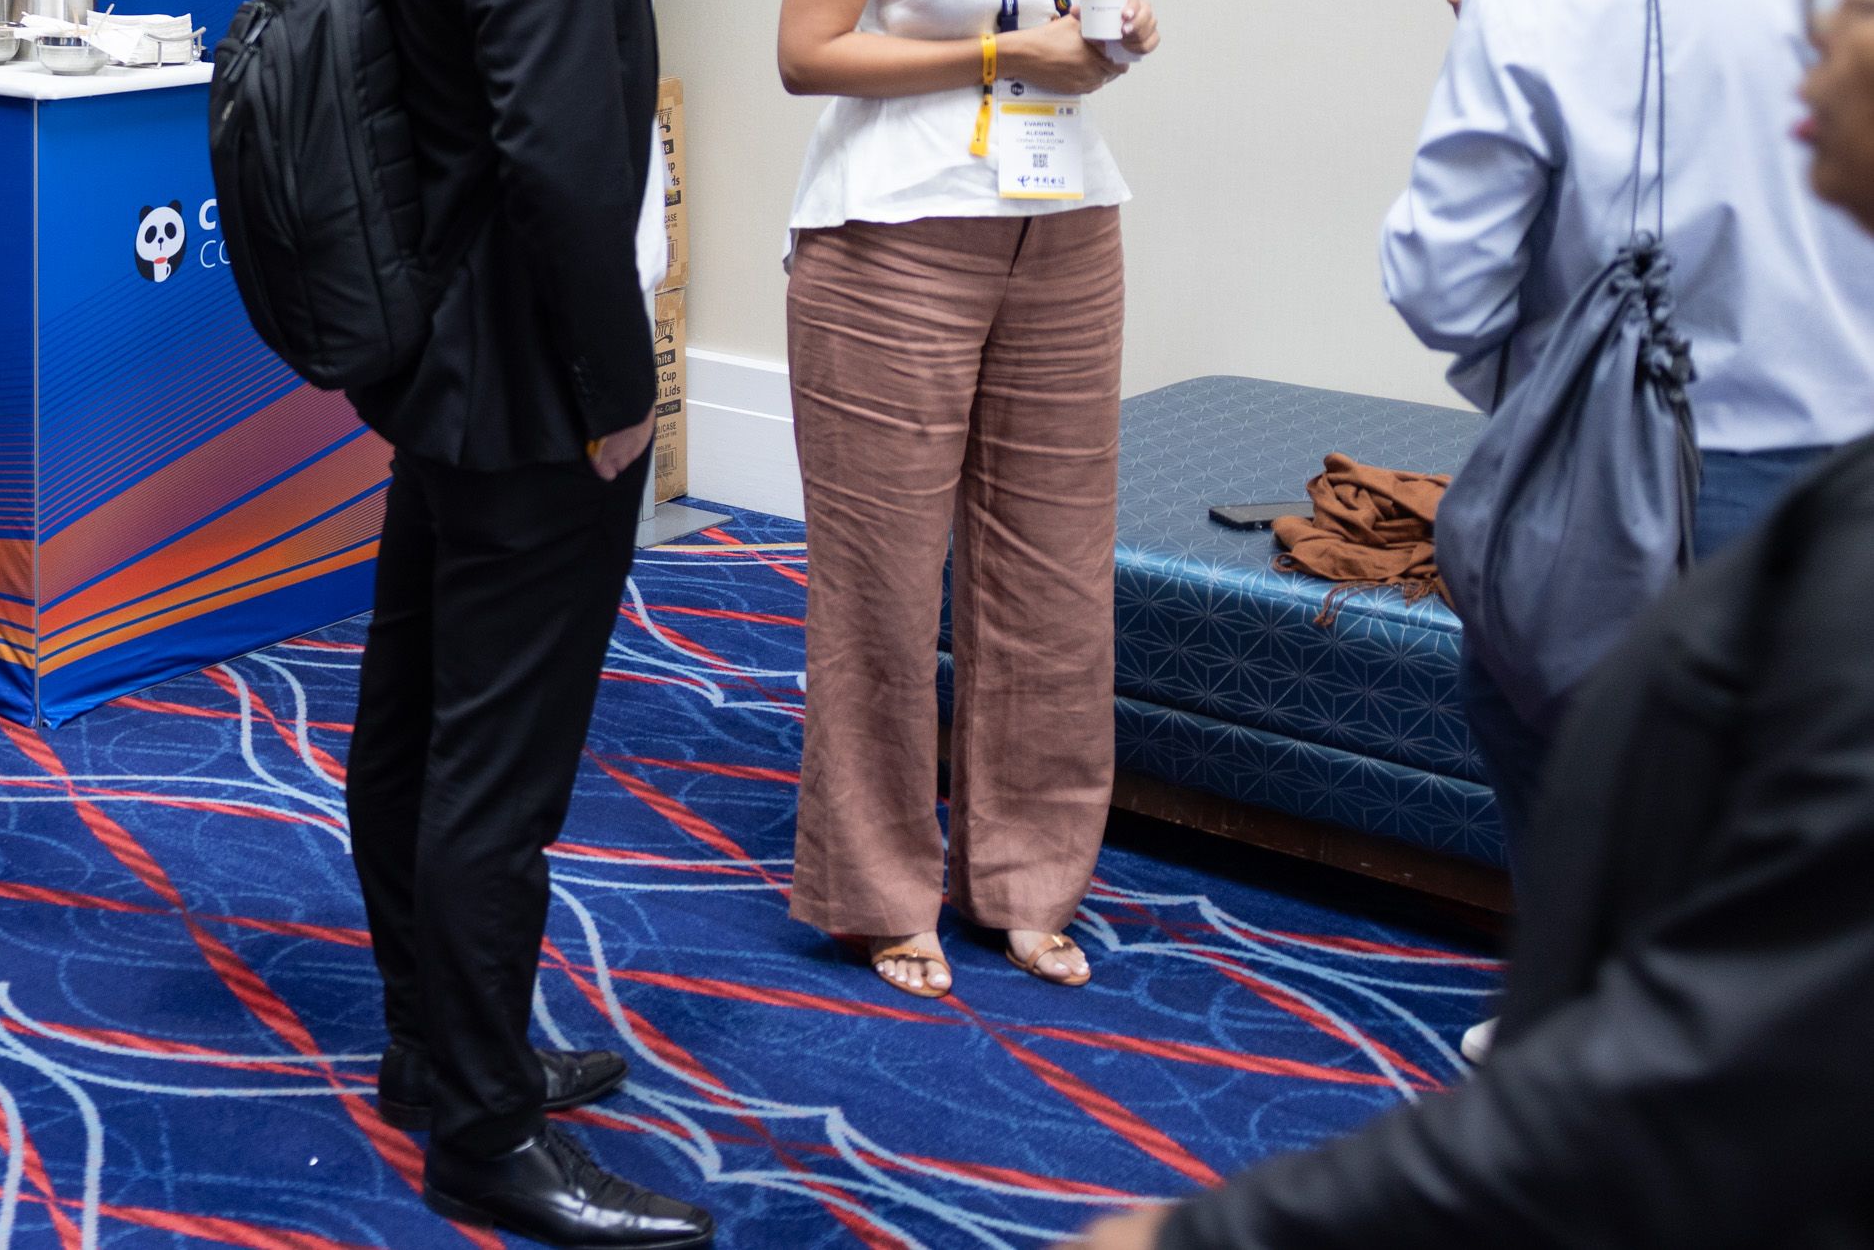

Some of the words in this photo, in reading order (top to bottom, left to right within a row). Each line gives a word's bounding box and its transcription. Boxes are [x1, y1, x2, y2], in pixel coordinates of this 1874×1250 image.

[655, 323, 675, 338] OICE
[661, 371, 677, 383] Cup
[665, 384, 681, 398] Lids
